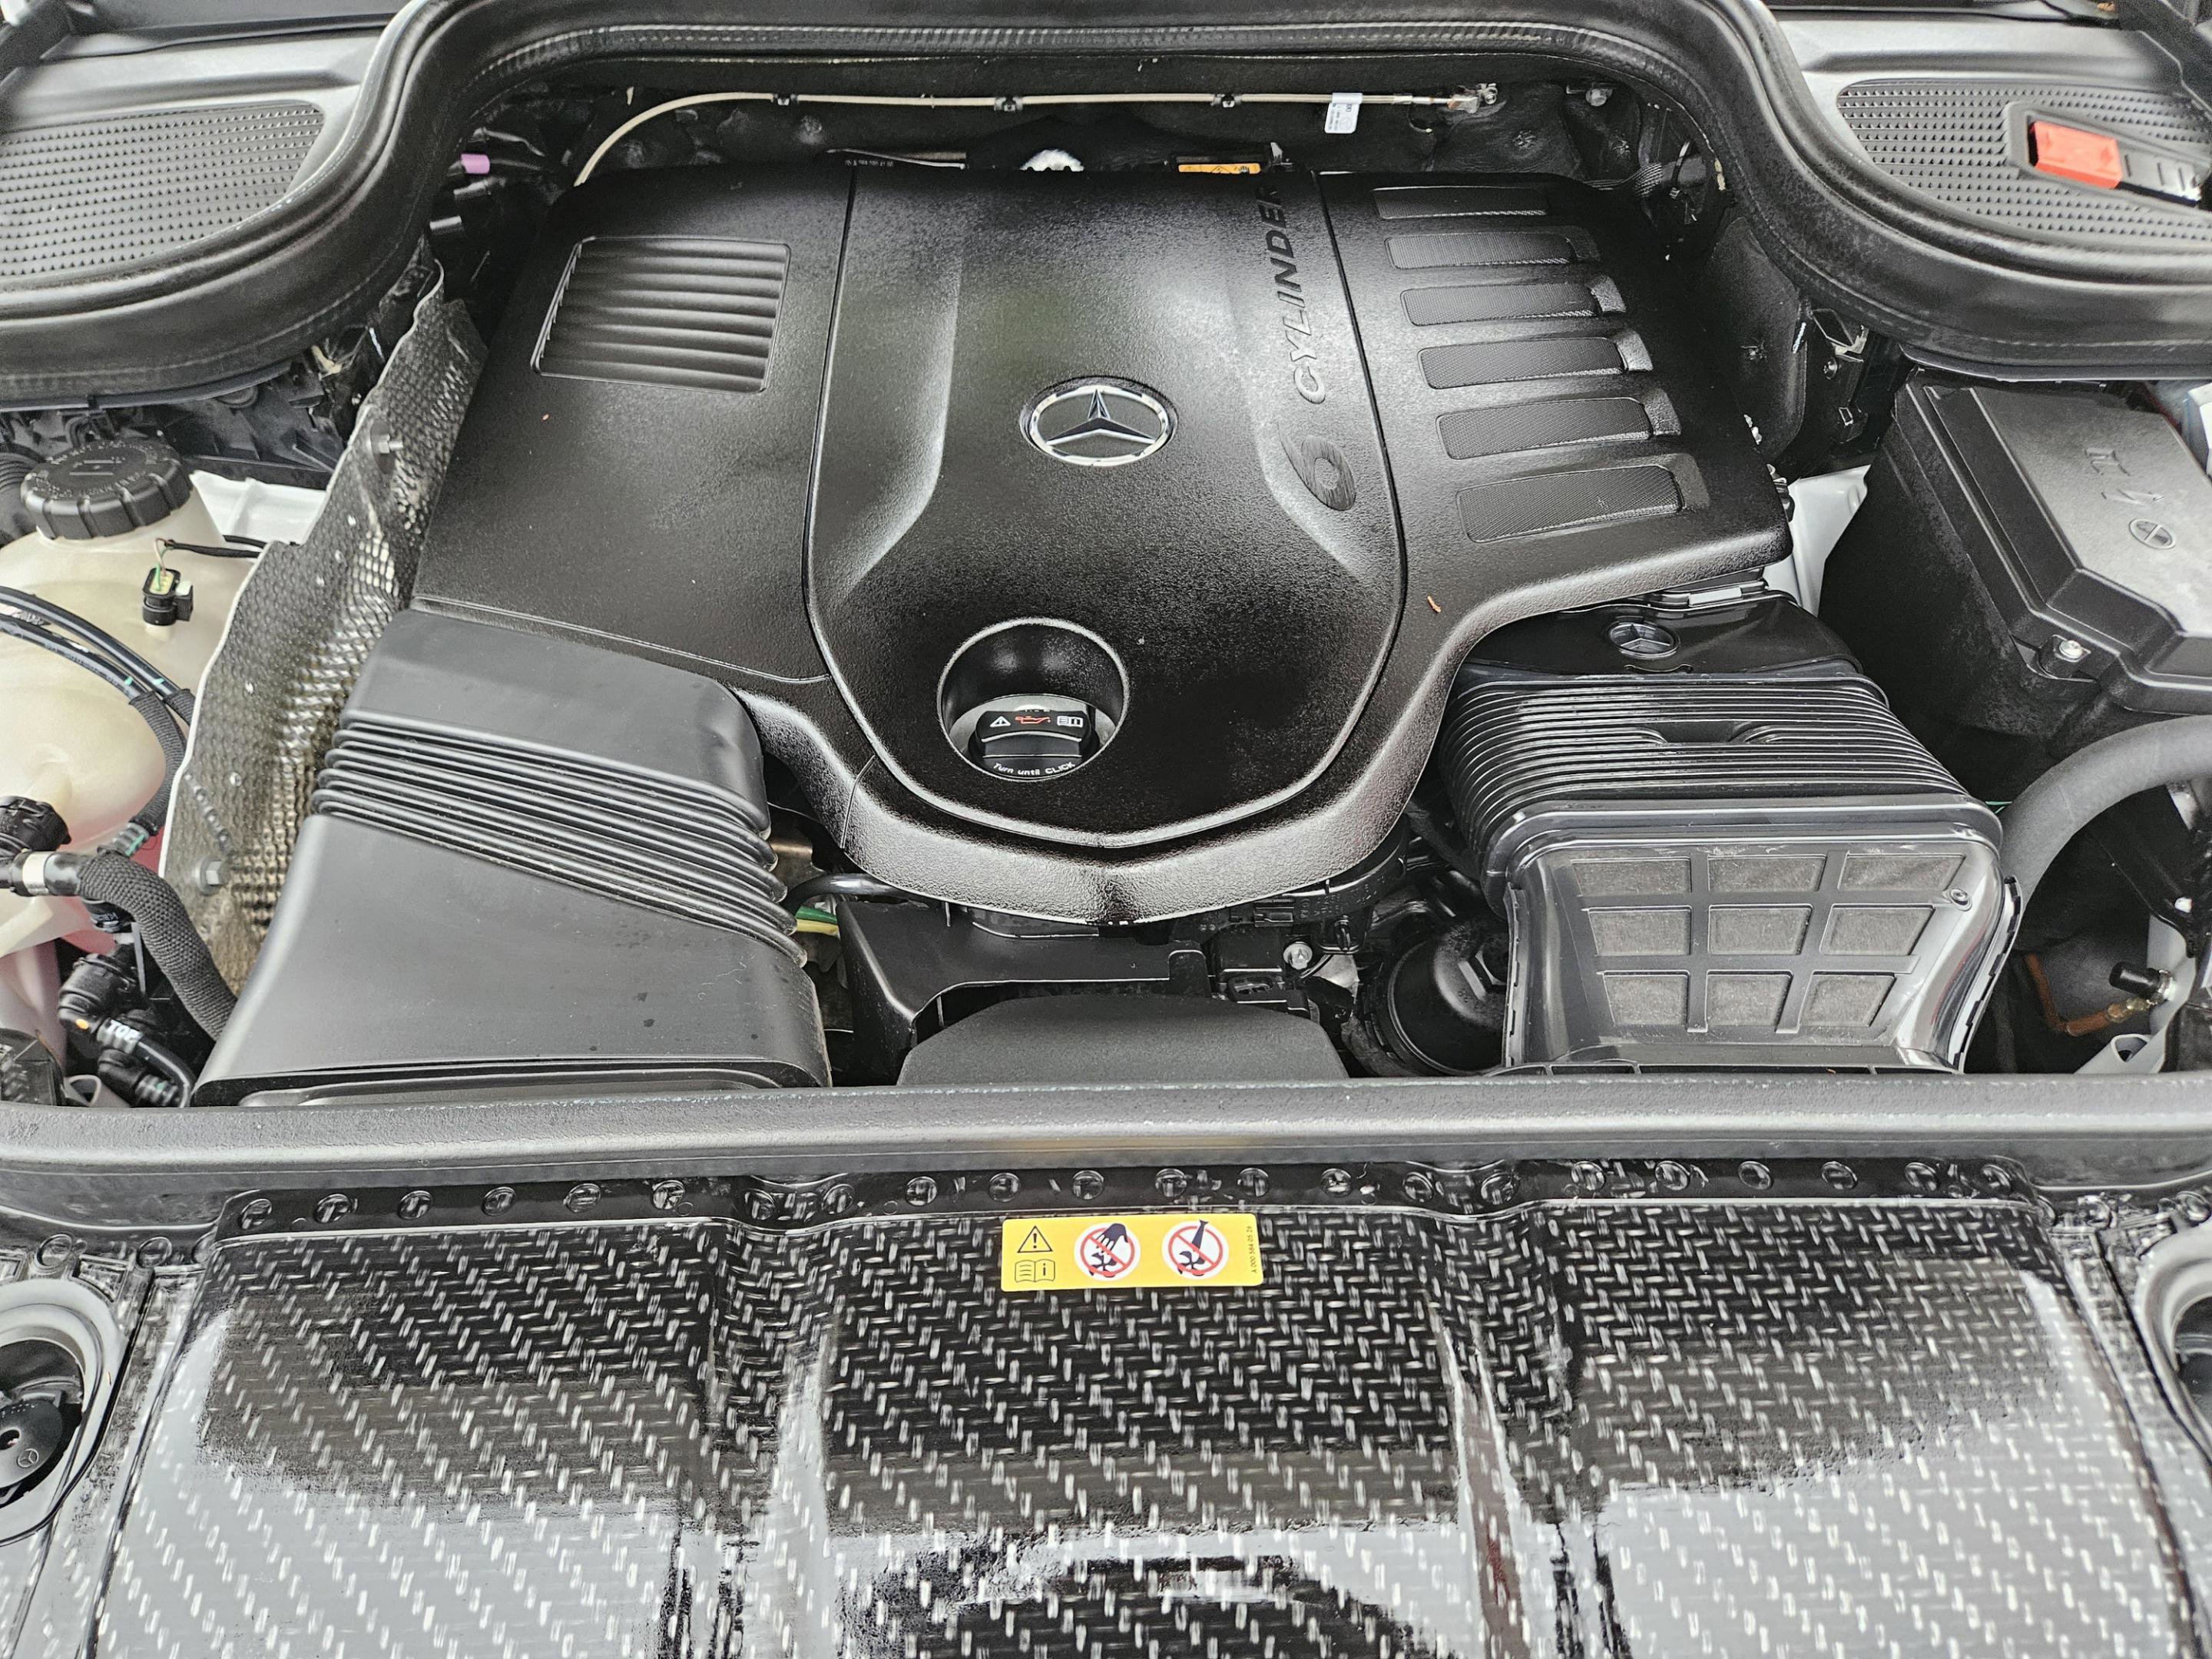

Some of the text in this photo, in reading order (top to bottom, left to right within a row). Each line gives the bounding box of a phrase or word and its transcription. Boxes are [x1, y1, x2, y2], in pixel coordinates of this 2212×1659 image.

[1277, 424, 1357, 512] 6
[993, 762, 1014, 774] Turn
[1045, 761, 1076, 775] CLICK
[104, 1018, 141, 1042] TOP
